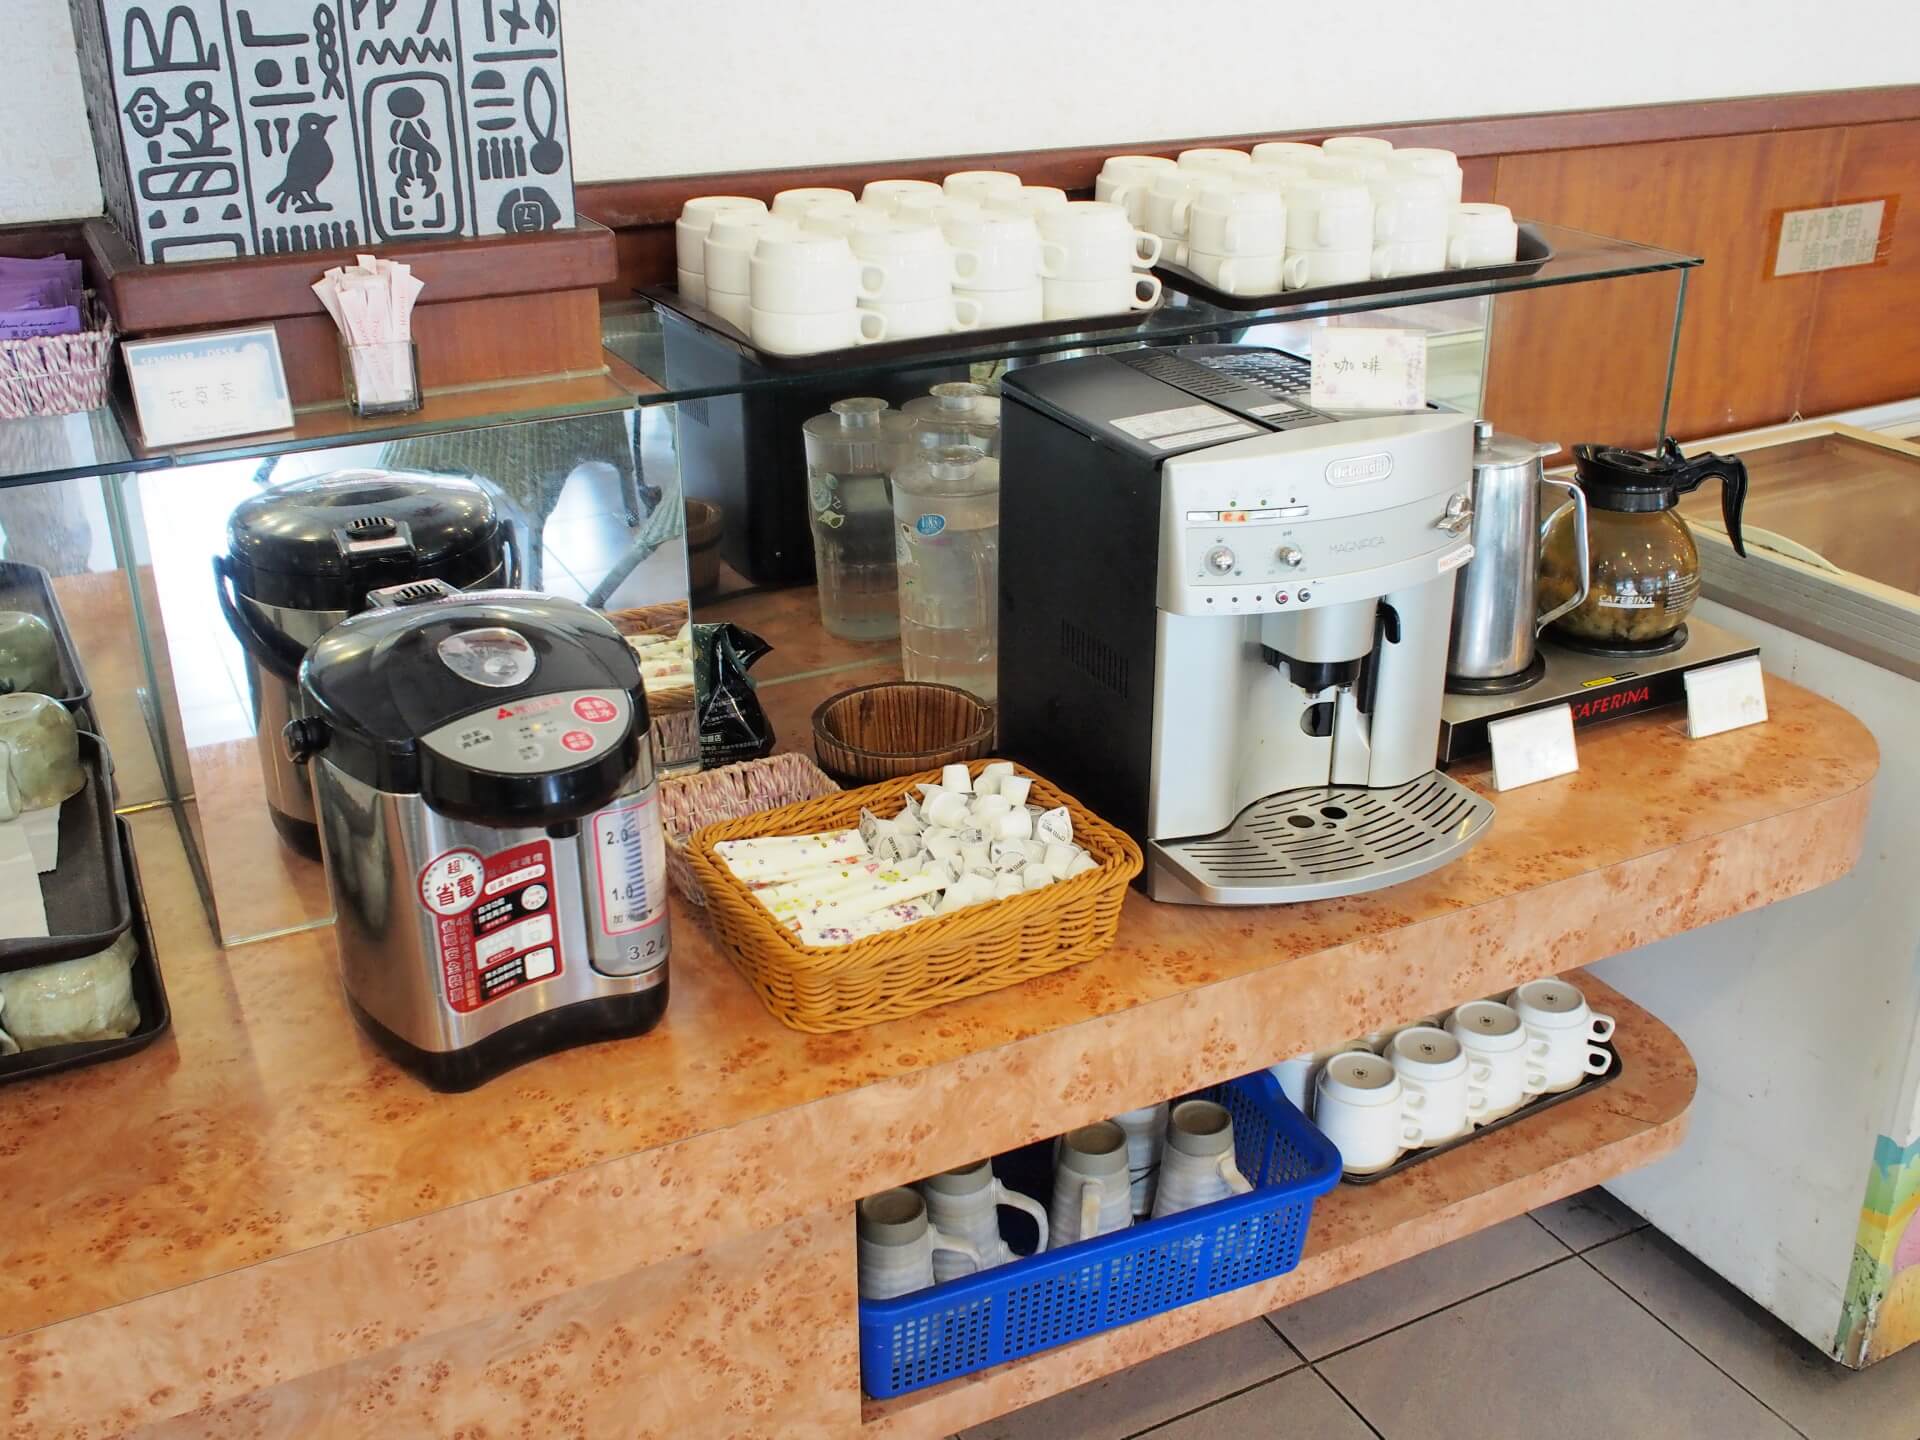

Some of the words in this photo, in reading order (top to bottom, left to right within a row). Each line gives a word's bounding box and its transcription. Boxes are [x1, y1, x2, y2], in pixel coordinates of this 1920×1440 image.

[1333, 353, 1384, 376] 咖啡
[1599, 594, 1653, 605] CAFERINA
[1570, 687, 1650, 721] CAFERINA
[606, 828, 630, 846] 2.0
[435, 873, 477, 907] 省電
[612, 884, 634, 902] 1.0
